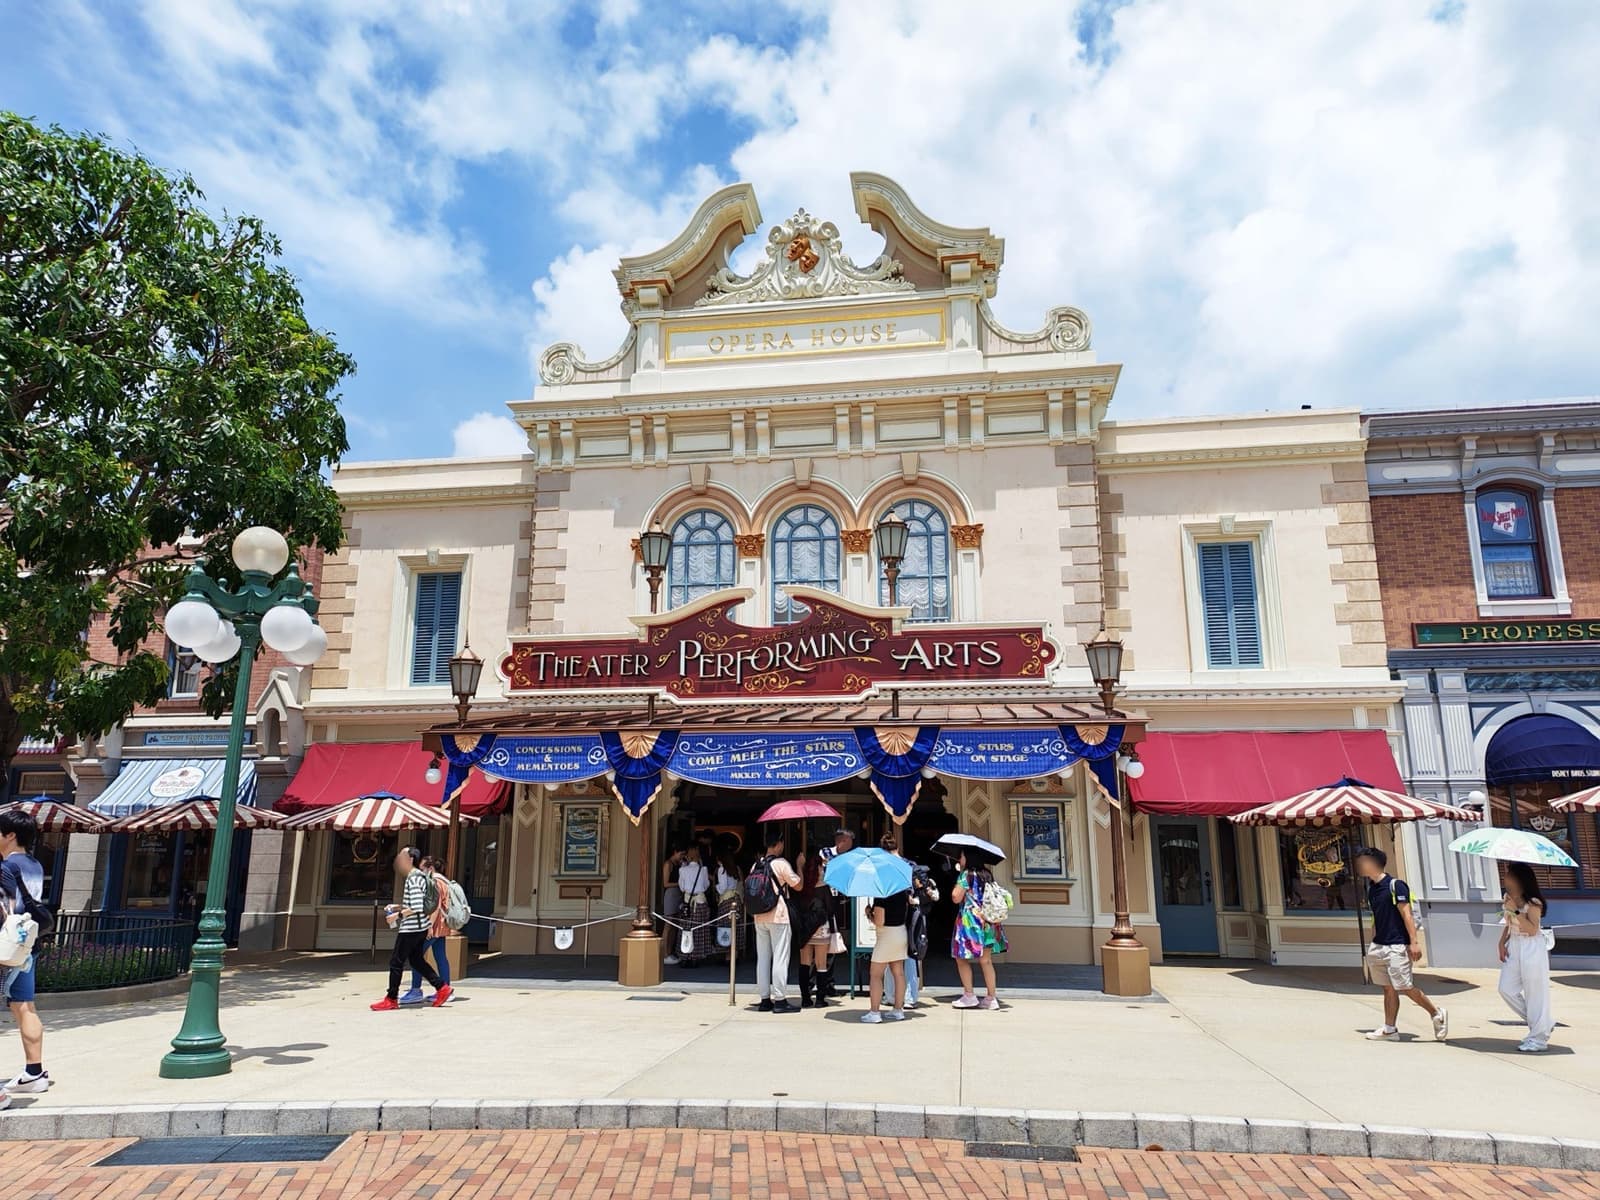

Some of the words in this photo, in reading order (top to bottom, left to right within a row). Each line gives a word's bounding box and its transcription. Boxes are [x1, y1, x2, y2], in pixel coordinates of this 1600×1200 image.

[708, 331, 794, 353] OPERA
[811, 322, 898, 347] HOUSE
[531, 651, 650, 681] THEATER
[655, 650, 676, 668] of
[679, 628, 876, 685] PERFORMING
[890, 638, 1002, 671] ARTS
[515, 745, 583, 754] CONCESSIONS
[978, 743, 1015, 751] STARS
[687, 755, 724, 767] COME
[730, 749, 766, 763] MEET
[772, 744, 799, 757] THE
[804, 740, 846, 752] STARS
[543, 754, 553, 763] &
[970, 754, 986, 763] ON
[990, 754, 1029, 763] STAGE
[515, 762, 580, 771] MEMENTOES
[731, 771, 761, 779] MICKEY
[765, 771, 772, 779] &
[776, 771, 811, 779] FRIENDS
